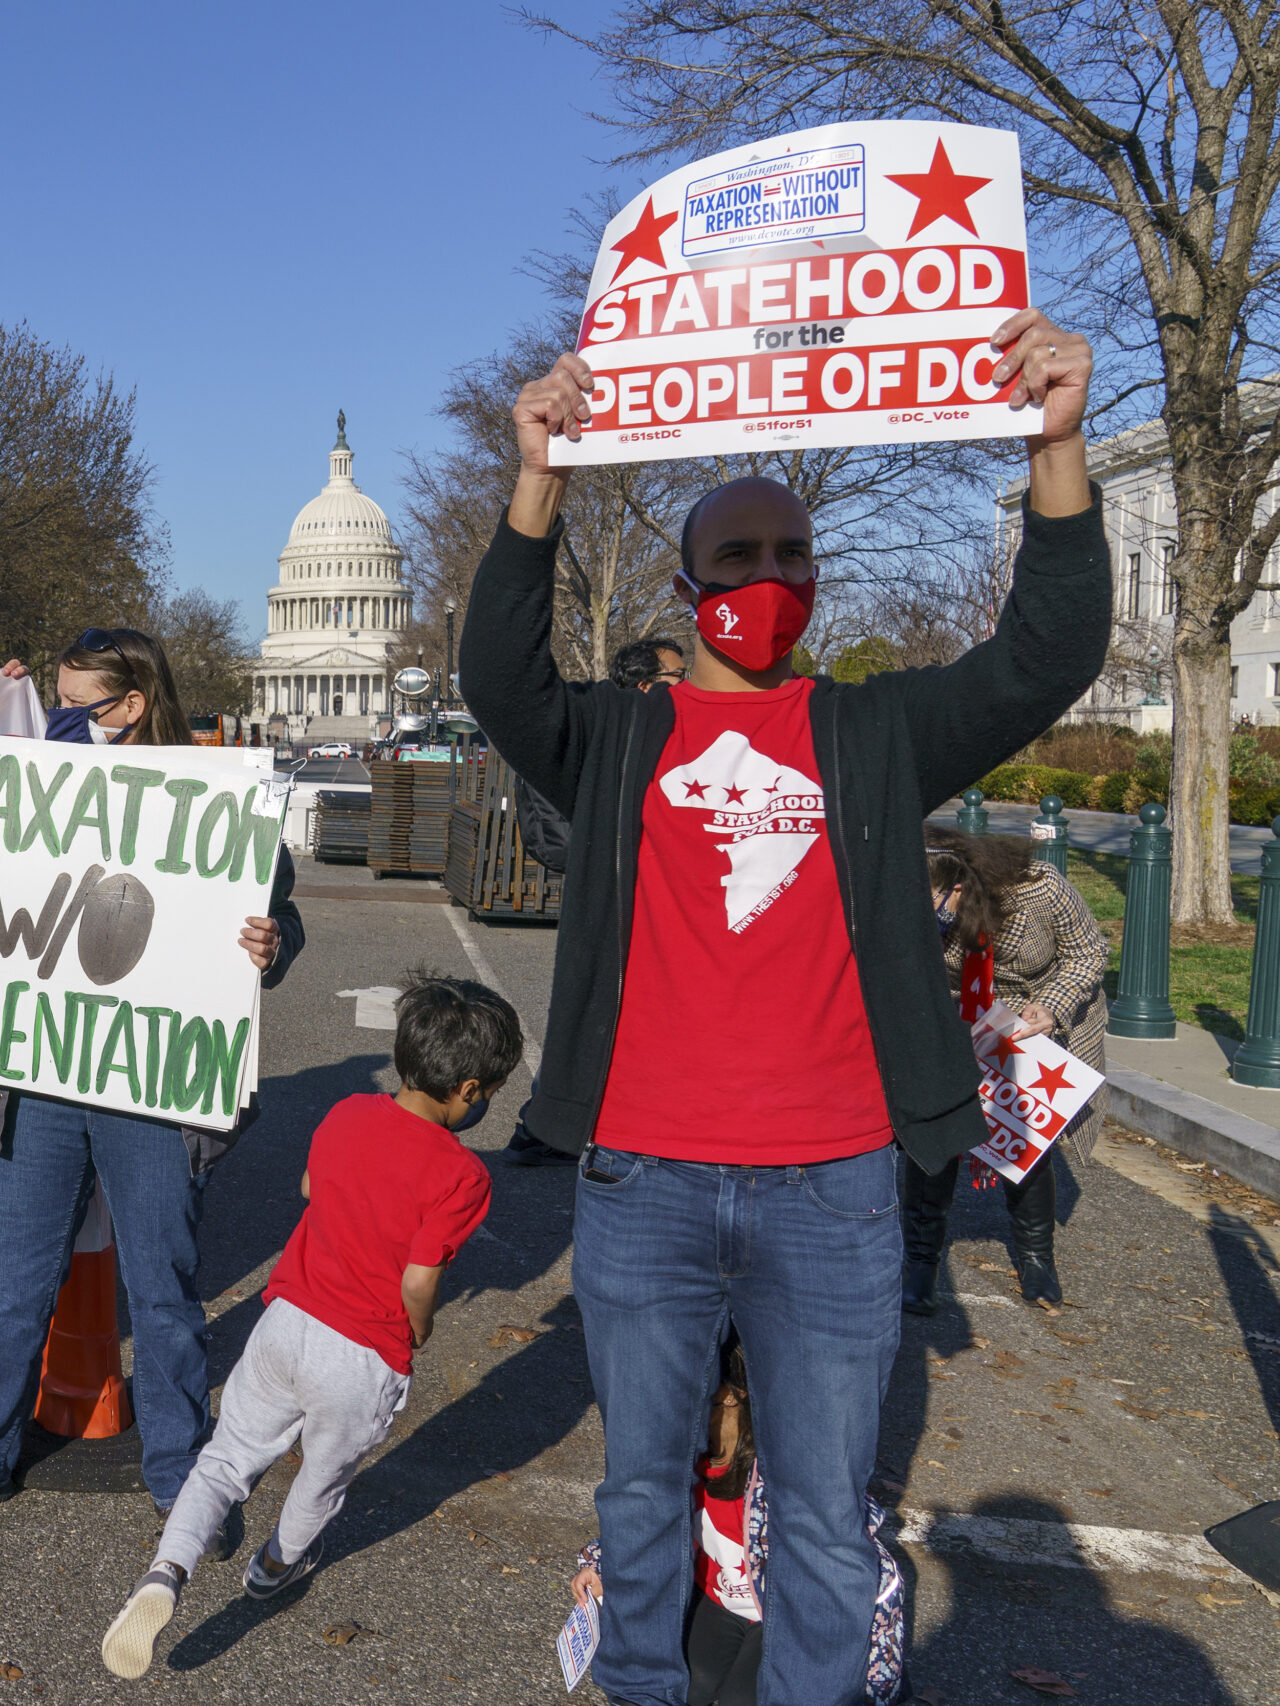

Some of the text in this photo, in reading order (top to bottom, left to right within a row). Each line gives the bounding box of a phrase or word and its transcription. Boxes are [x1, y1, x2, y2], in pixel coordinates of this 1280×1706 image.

[726, 158, 794, 183] Washington,
[688, 167, 860, 217] TAXATION WITHOUT
[705, 193, 839, 233] REPRESENTATION
[728, 225, 815, 244] www.dcvote.org
[588, 248, 1005, 343] STATEHOOD
[753, 322, 845, 349] for the
[580, 341, 1001, 428] PEOPLE OF DC
[618, 408, 970, 444] @51stDC @51for51 @DC_Vote
[732, 818, 816, 843] FOR D.C.
[989, 1127, 1027, 1160] DC
